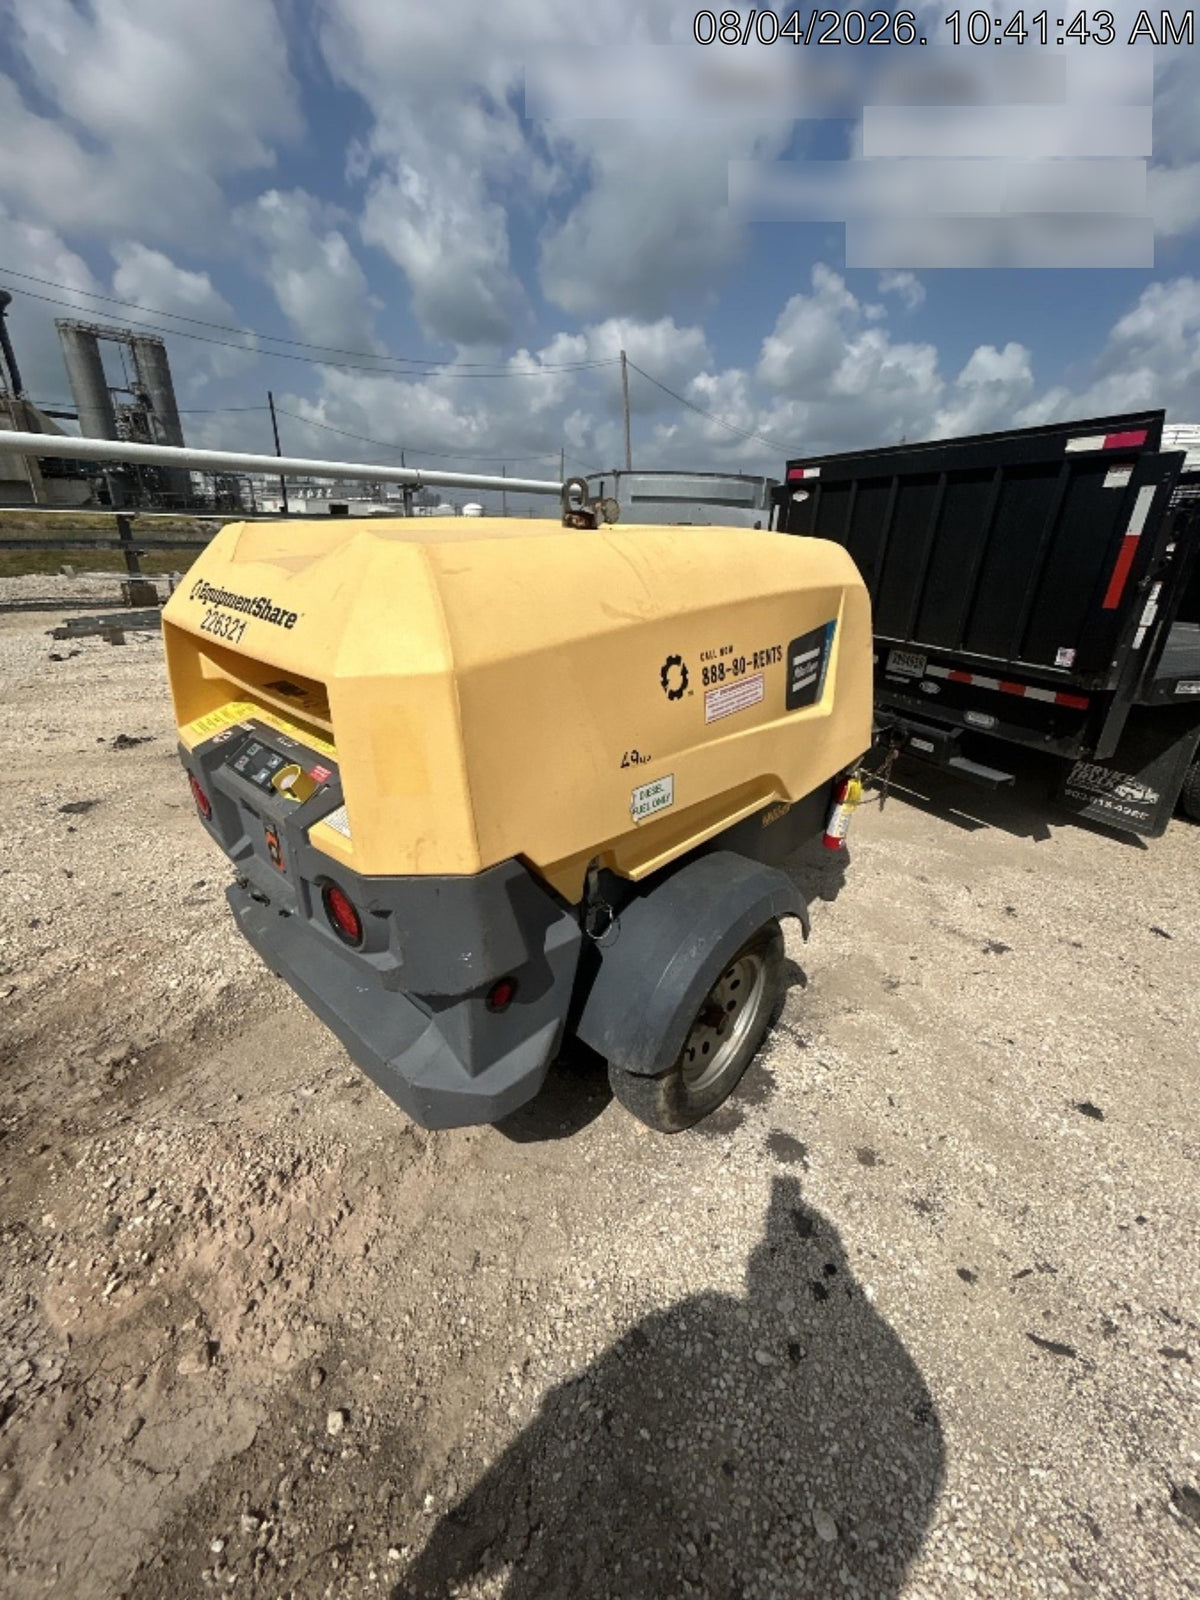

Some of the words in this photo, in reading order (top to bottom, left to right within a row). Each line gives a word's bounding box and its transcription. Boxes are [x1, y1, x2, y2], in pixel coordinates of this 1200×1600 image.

[199, 582, 298, 629] EquipmentShare
[200, 609, 248, 644] 226321
[702, 645, 783, 687] 888-80-RENTS
